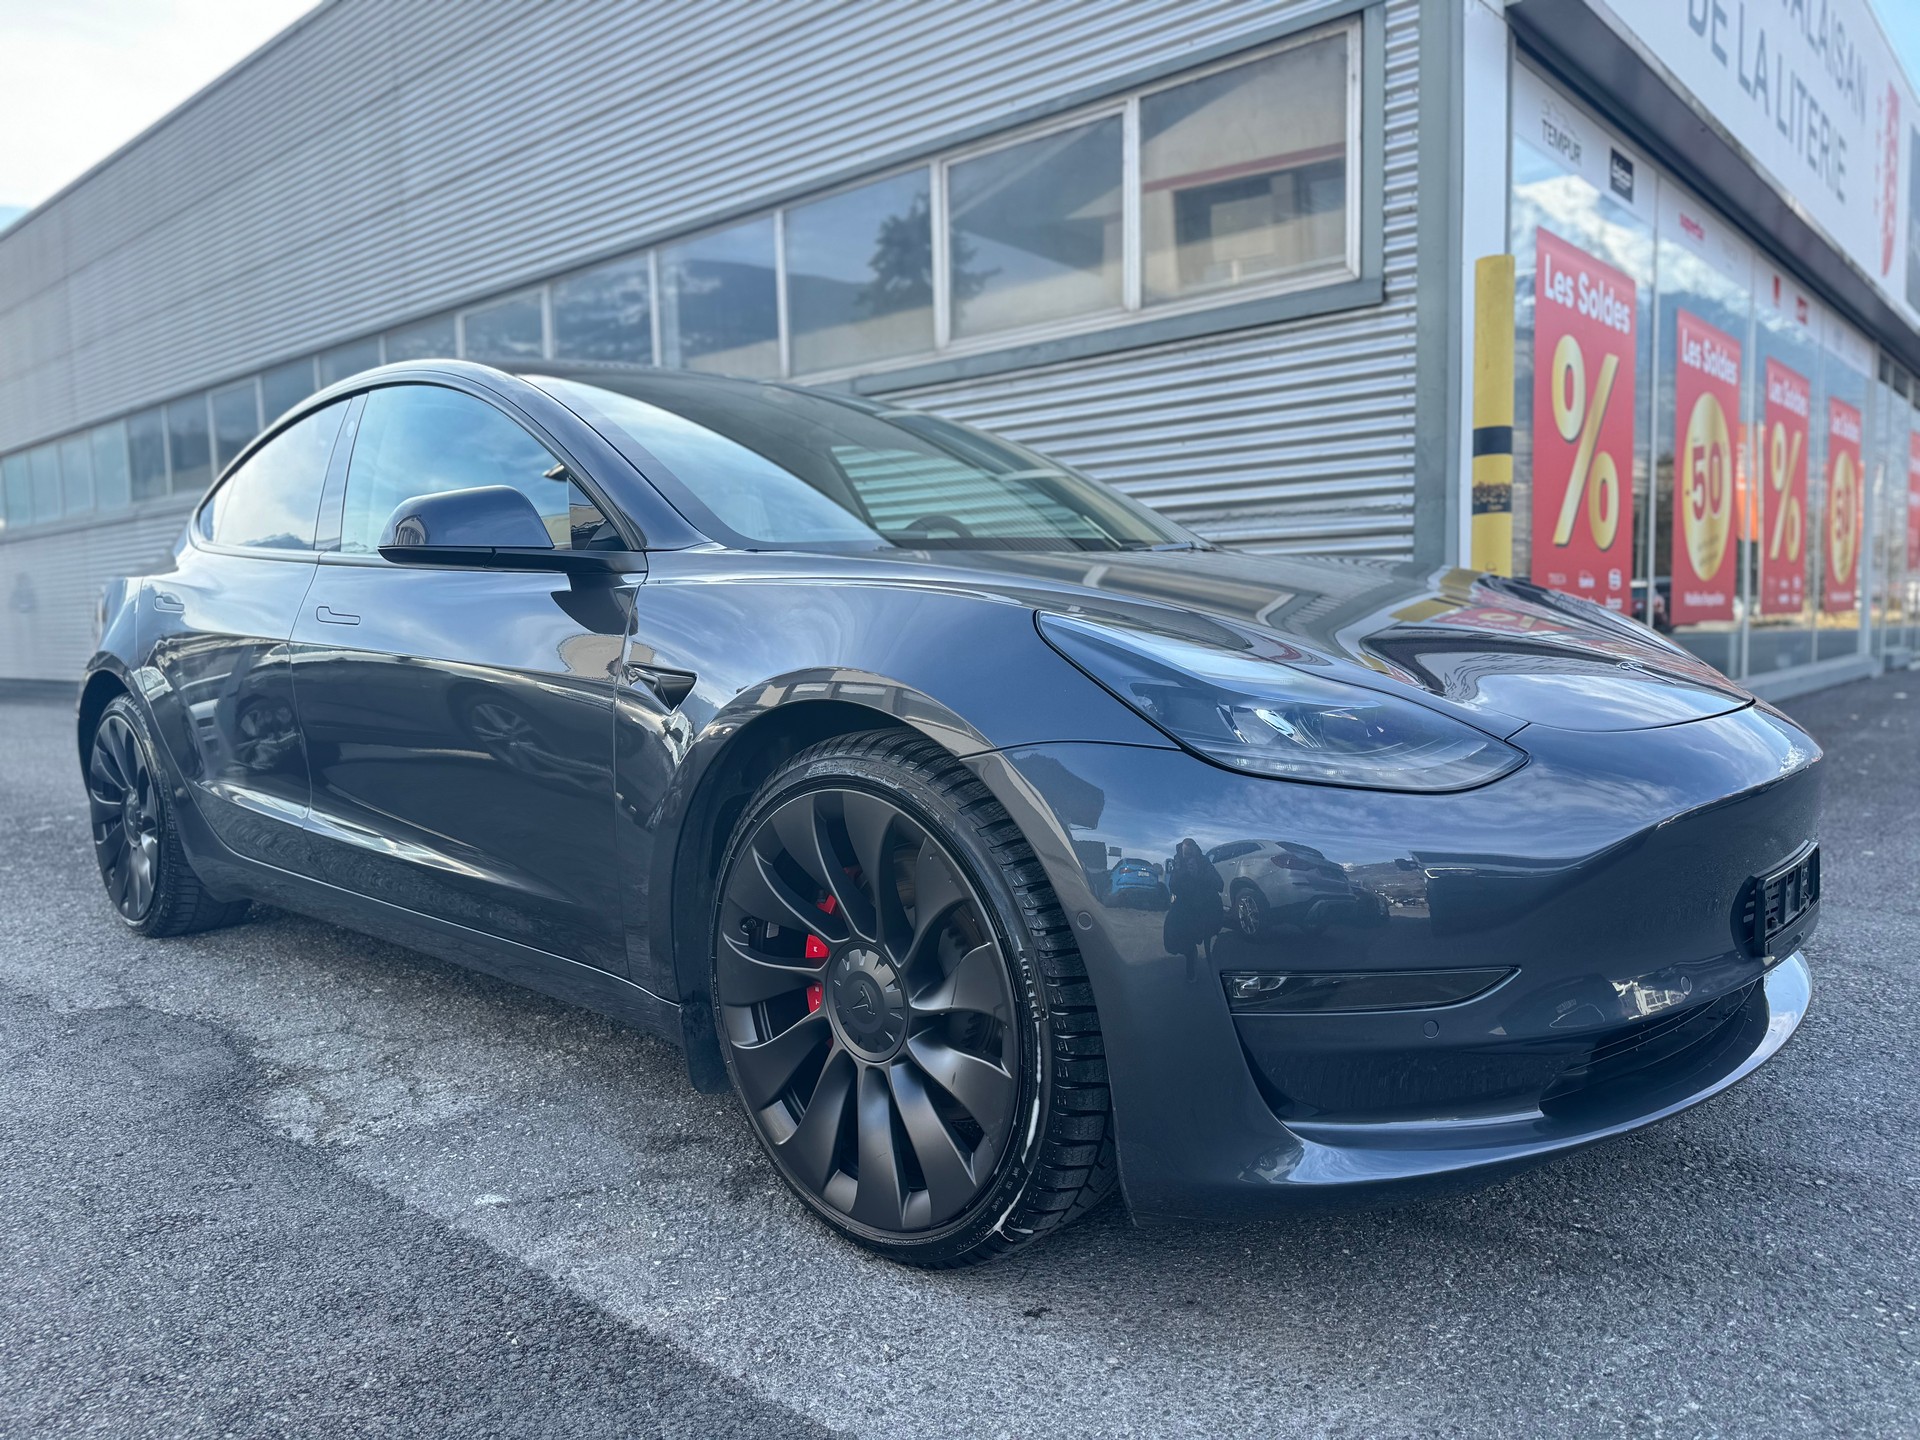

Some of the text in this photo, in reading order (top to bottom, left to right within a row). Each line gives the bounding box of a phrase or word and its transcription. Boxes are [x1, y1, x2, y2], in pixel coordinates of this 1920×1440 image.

[1737, 2, 1770, 117] LA
[1777, 52, 1847, 204] LITERIE
[1782, 0, 1867, 127] LAISAN
[1541, 118, 1582, 167] TEMPUR
[1544, 252, 1630, 335] Les Soldes
[1681, 327, 1738, 386] Les Soldes
[1692, 441, 1723, 521] 50
